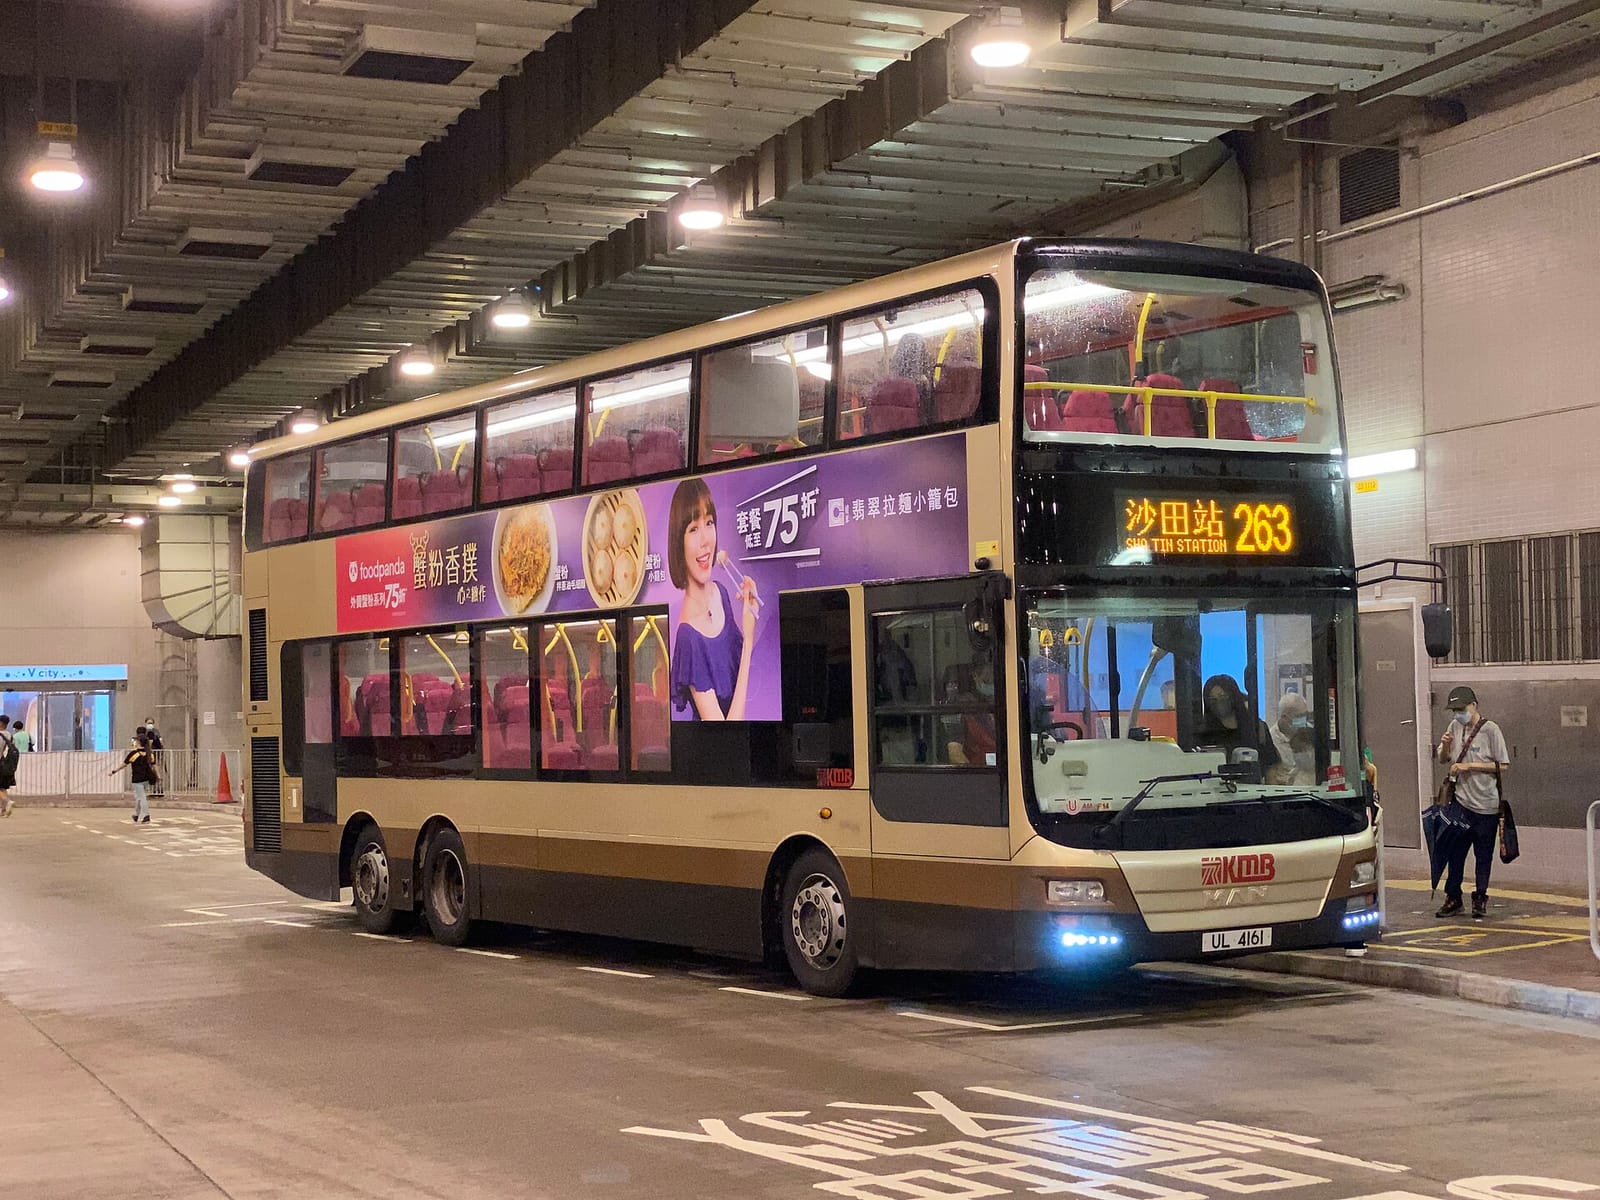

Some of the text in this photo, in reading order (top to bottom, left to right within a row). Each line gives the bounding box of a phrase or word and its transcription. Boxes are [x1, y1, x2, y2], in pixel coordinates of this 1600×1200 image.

[852, 486, 959, 521] 翡翠拉麵小籠包
[736, 507, 762, 534] 套餐
[1125, 498, 1293, 552] 沙田站 263
[744, 531, 762, 550] 低至
[1126, 538, 1228, 553] SHA TIN STATION
[359, 556, 406, 582] foodpanda
[27, 668, 59, 679] V city
[826, 768, 855, 787] KMB
[1222, 853, 1276, 885] KMB
[1211, 930, 1264, 950] UL 4161
